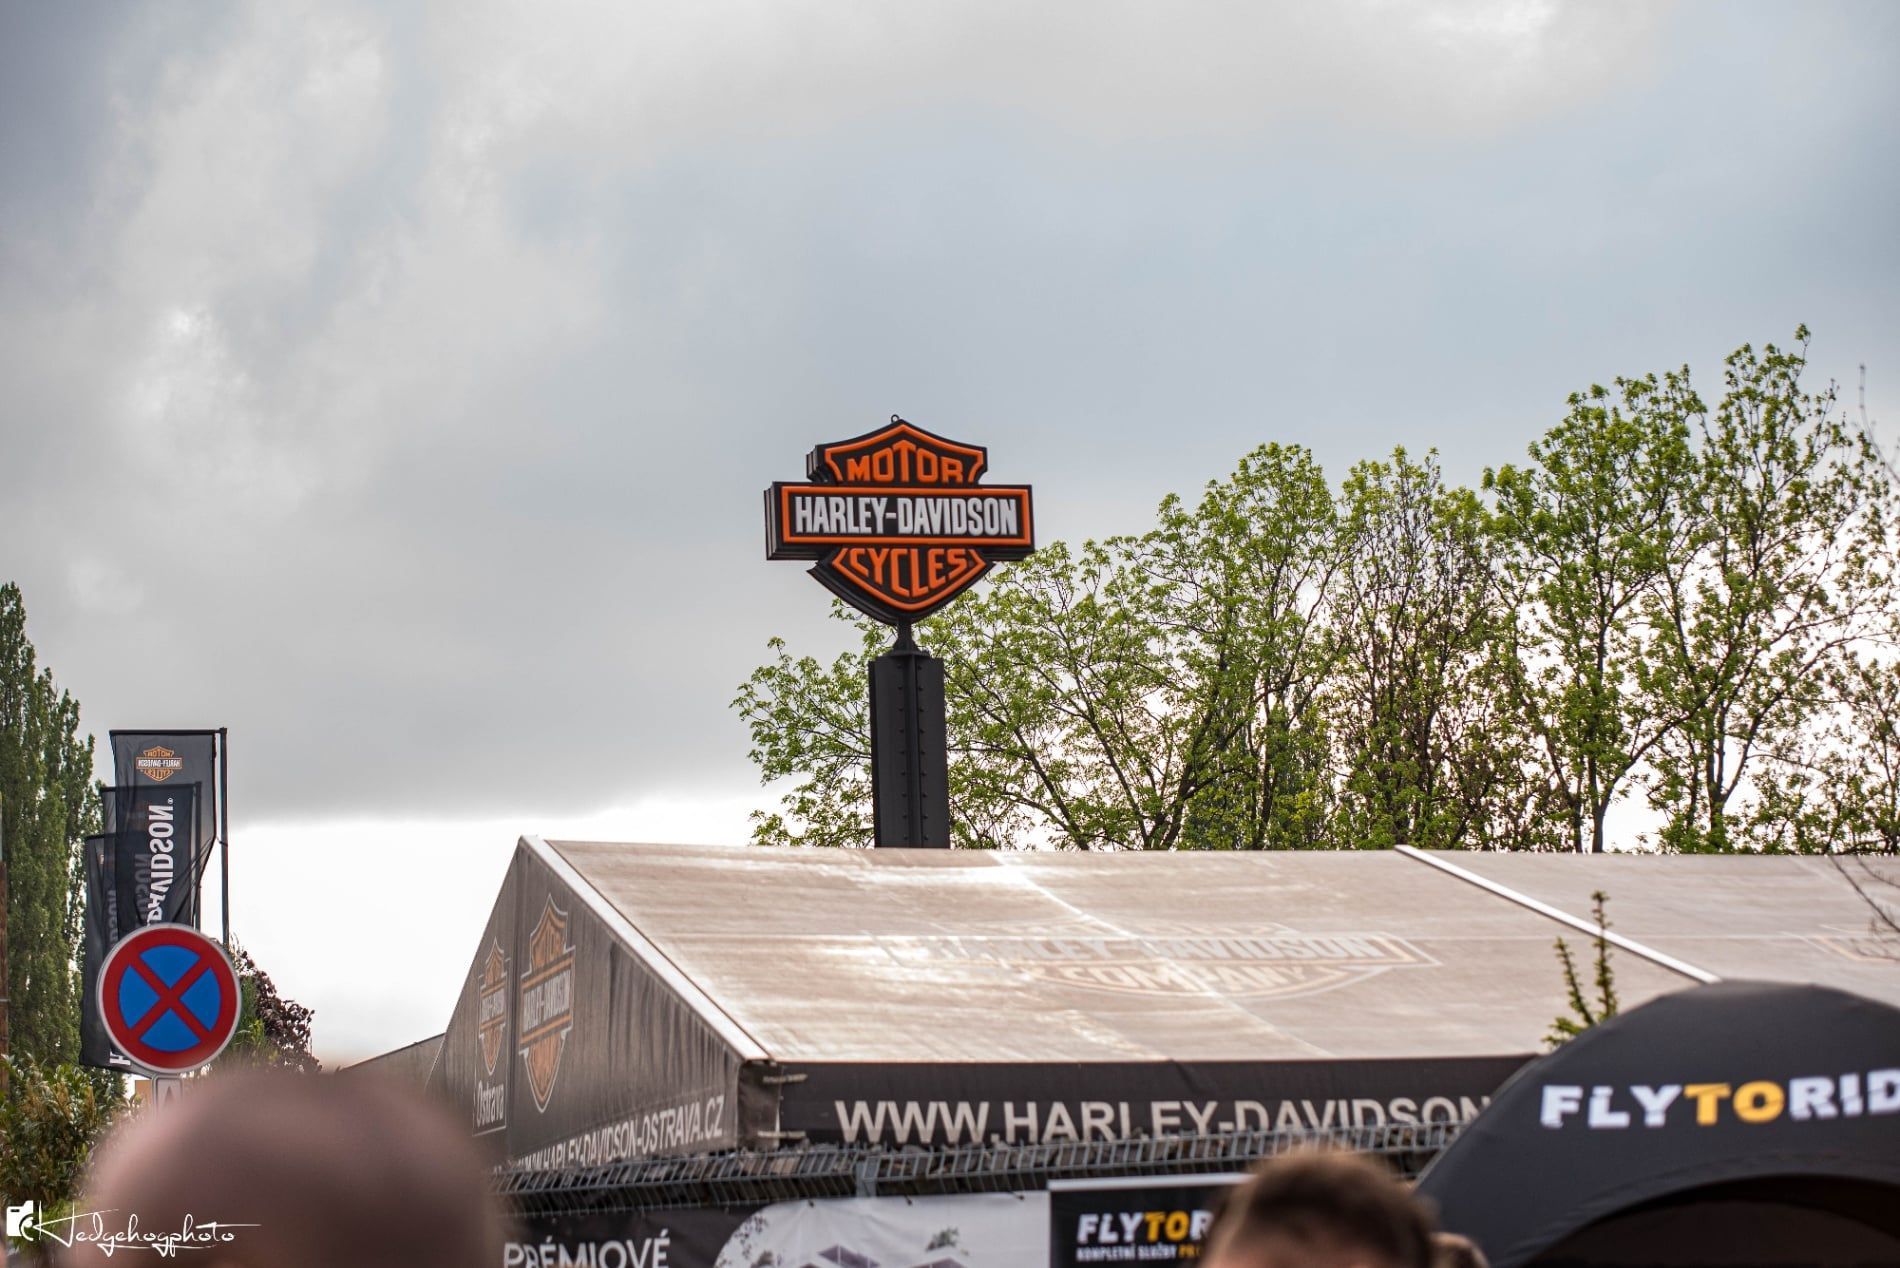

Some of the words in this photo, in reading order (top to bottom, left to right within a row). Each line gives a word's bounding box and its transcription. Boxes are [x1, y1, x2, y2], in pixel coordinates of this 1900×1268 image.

[846, 439, 963, 483] MOTOR
[794, 496, 1018, 536] HARLEY-DAVIDSON
[849, 547, 968, 598] CYCLES
[515, 1094, 724, 1172] HARLEY-DAVIDSON-OSTRAVA.CZ
